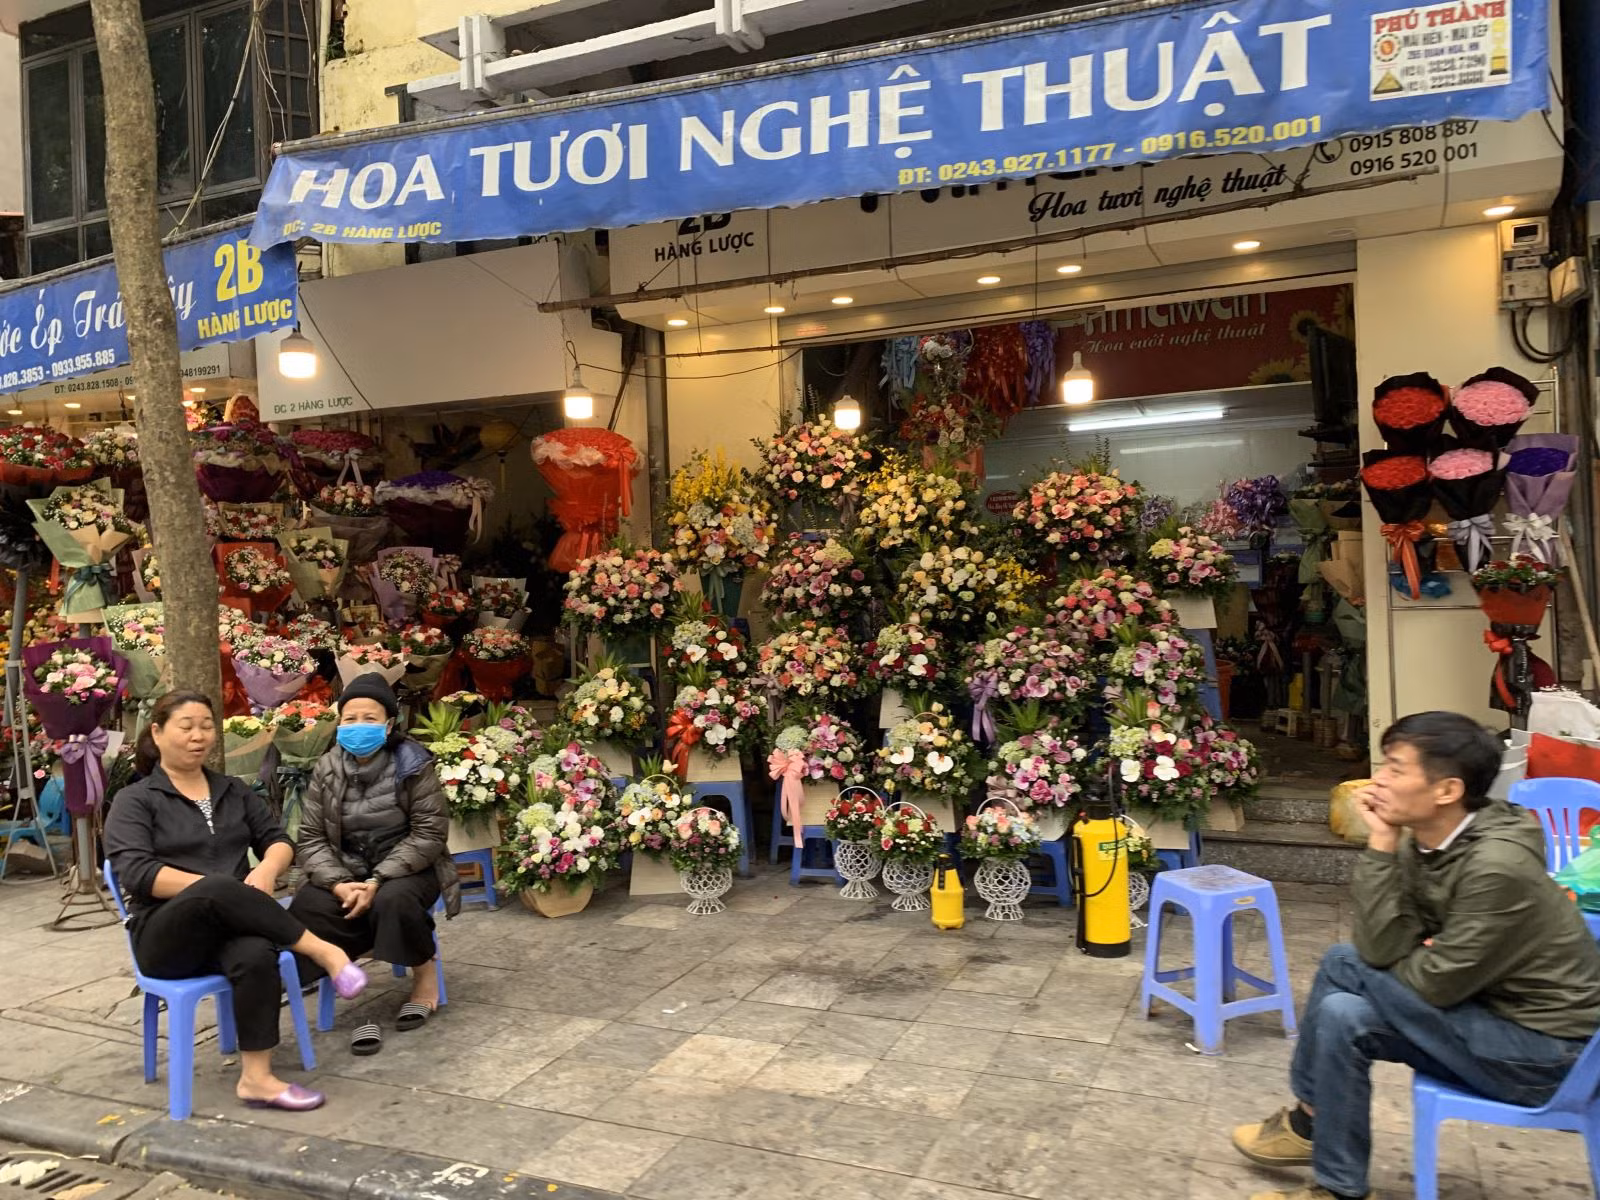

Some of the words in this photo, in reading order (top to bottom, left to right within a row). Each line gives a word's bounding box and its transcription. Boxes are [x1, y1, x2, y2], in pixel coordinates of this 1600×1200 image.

[1375, 9, 1419, 35] PHÚ
[288, 154, 445, 210] HOA
[470, 122, 648, 197] TƯƠI
[680, 64, 933, 172] NGHỆ
[962, 10, 1333, 132] THUẬT
[898, 168, 932, 186] ĐT:
[938, 142, 1115, 182] 0243.927.1177
[1140, 115, 1322, 155] 0916.520.001
[1350, 131, 1394, 153] 0915
[1399, 125, 1437, 145] 808
[1350, 155, 1394, 176] 0916
[1401, 149, 1437, 168] 520
[1443, 142, 1478, 163] 001
[1028, 191, 1087, 223] Hoa
[1099, 186, 1145, 211] tươi
[1153, 175, 1212, 208] nghệ
[1221, 164, 1287, 194] thuật
[310, 222, 338, 235] 2B
[342, 224, 395, 239] HÀNG
[397, 221, 442, 240] LƯỢC
[654, 239, 703, 263] HÀNG
[709, 231, 755, 256] LƯỢC
[214, 239, 264, 302] 2B
[197, 310, 241, 340] HÀNG
[244, 299, 293, 327] LƯỢC
[52, 349, 115, 378] 0933.955.885
[68, 378, 119, 393] 0243.828.1508
[290, 403, 296, 413] 2
[299, 399, 324, 411] HÀNG
[328, 396, 353, 409] LƯỢC
